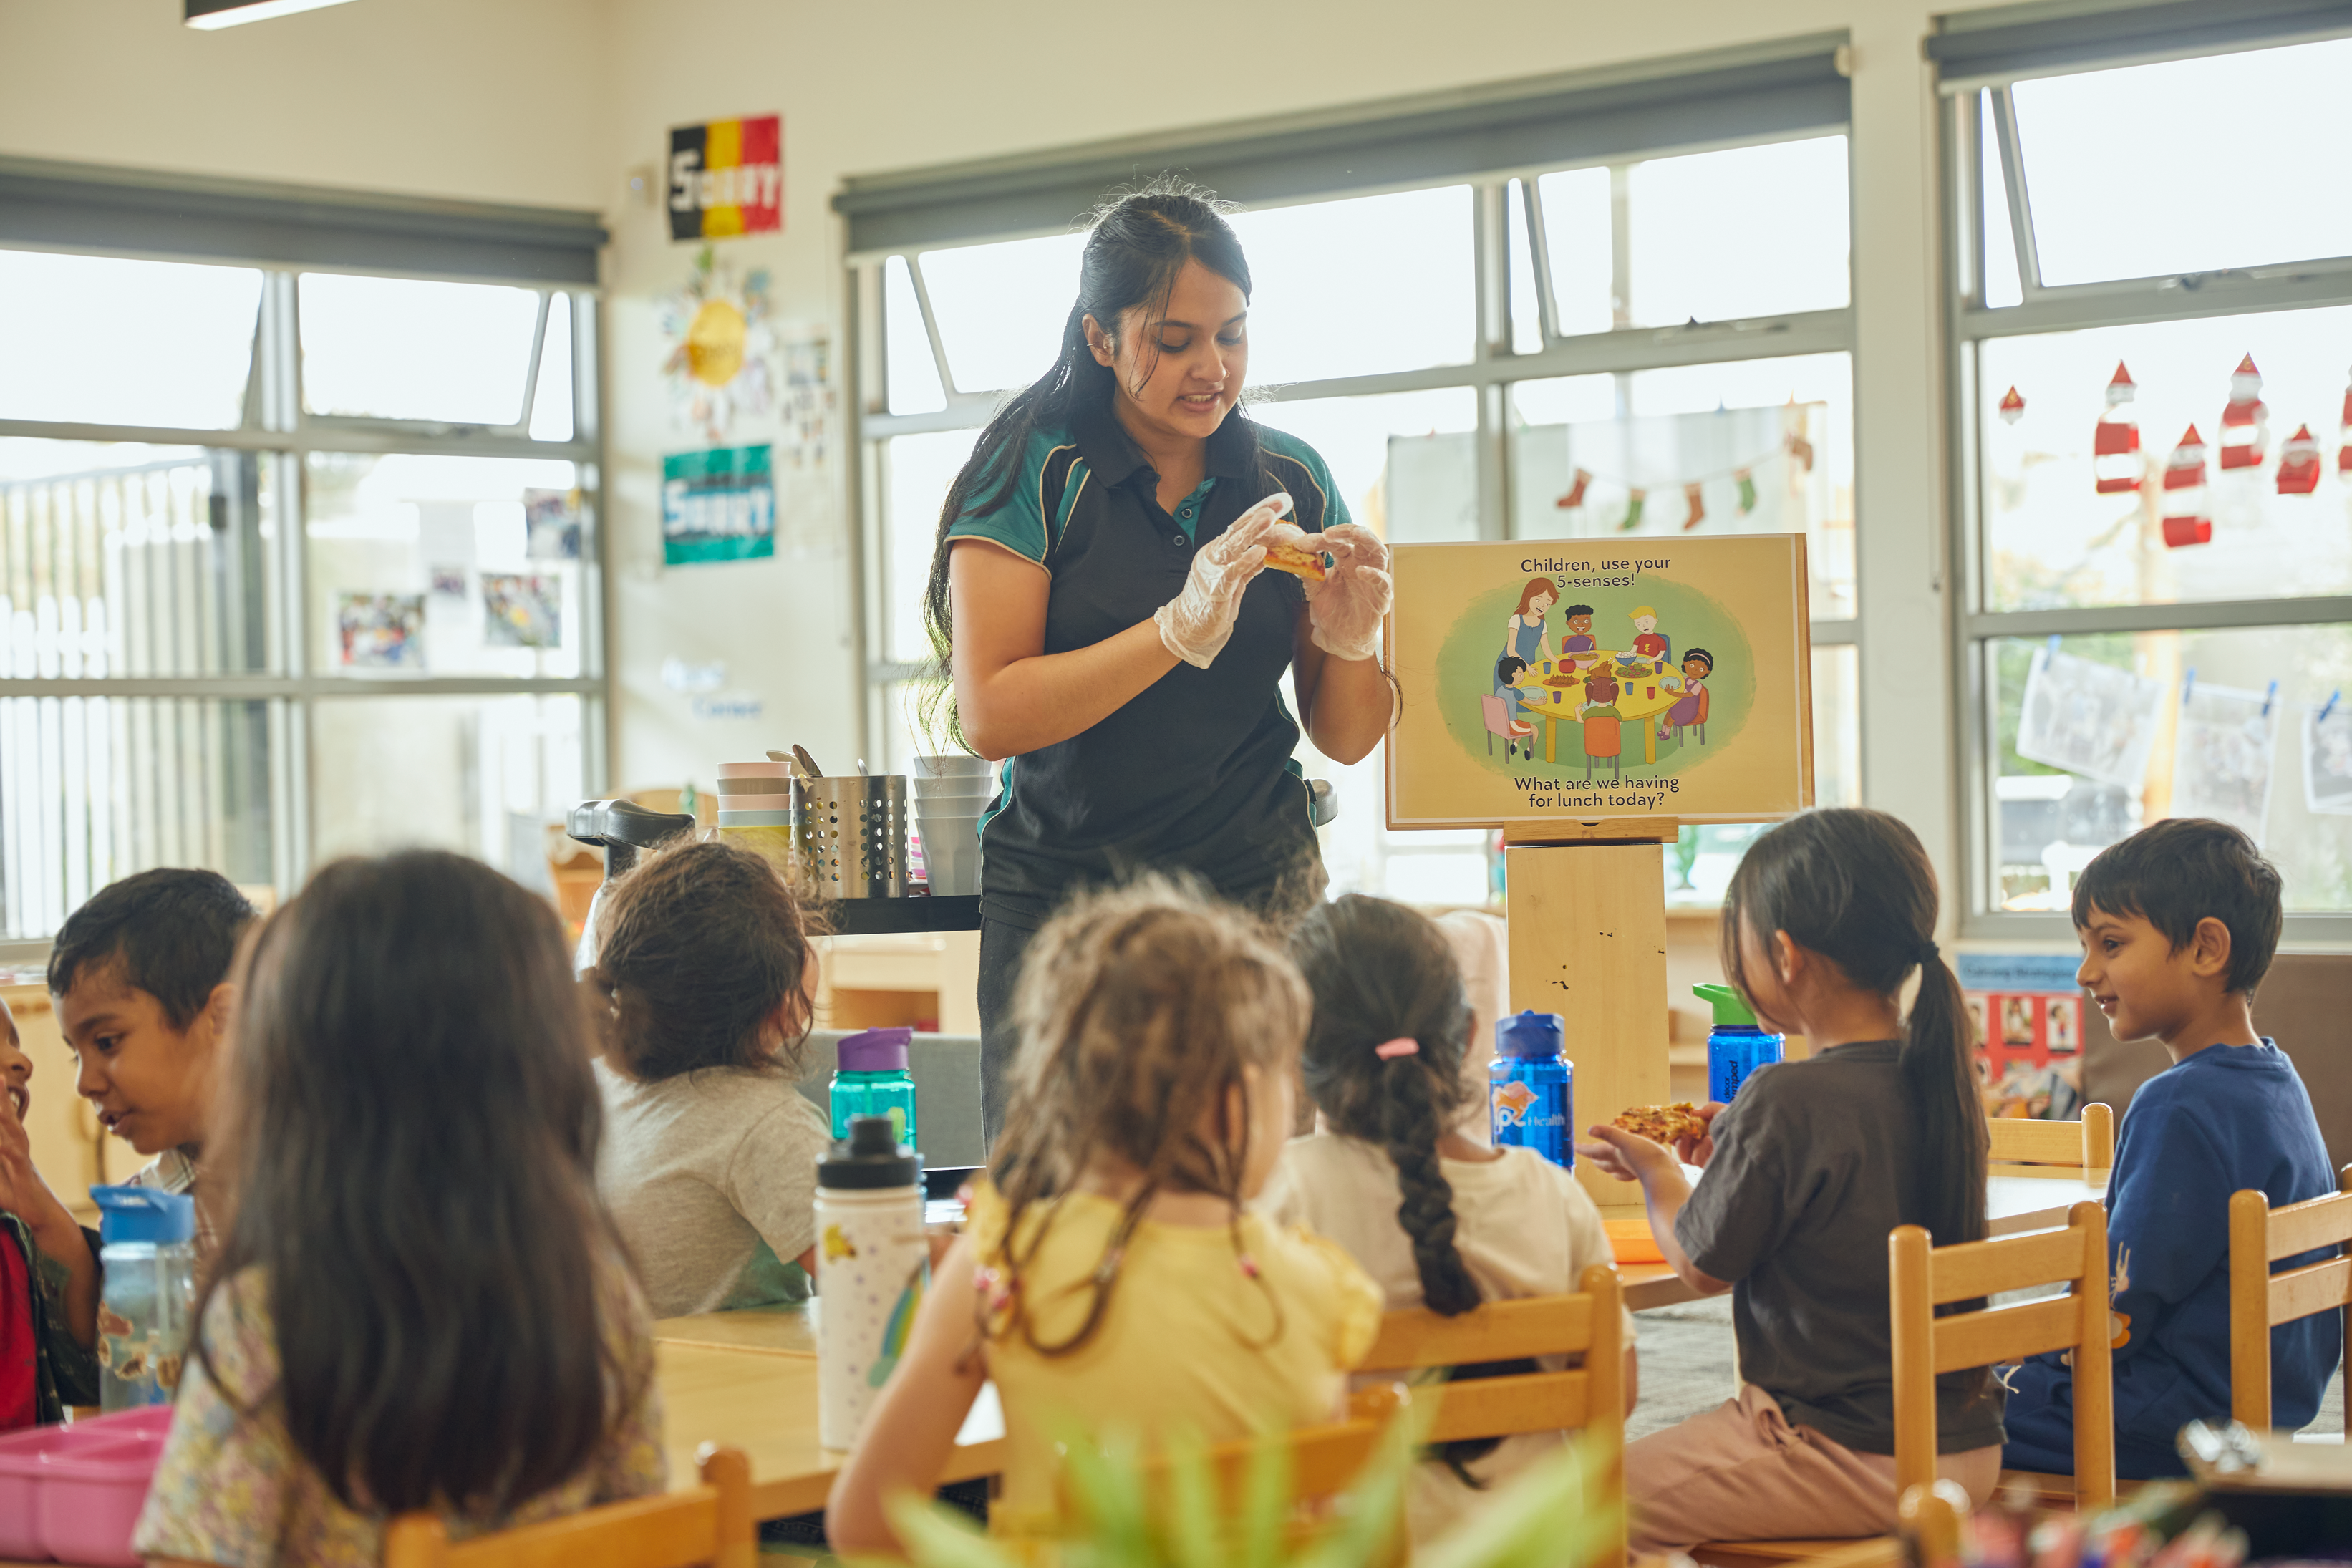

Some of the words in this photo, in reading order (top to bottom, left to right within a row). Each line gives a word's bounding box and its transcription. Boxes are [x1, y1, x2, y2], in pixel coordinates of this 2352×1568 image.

[1521, 558, 1595, 573] Children,
[1601, 560, 1630, 570] use
[1635, 558, 1670, 574] your
[1557, 573, 1635, 588] 5-senses!
[1514, 776, 1560, 790] What
[1565, 778, 1592, 790] are
[1597, 779, 1620, 789] we
[1625, 775, 1680, 793] having
[1529, 793, 1552, 808] for
[1558, 792, 1602, 807] lunch
[1607, 792, 1665, 810] today?
[1527, 1113, 1566, 1127] Health
